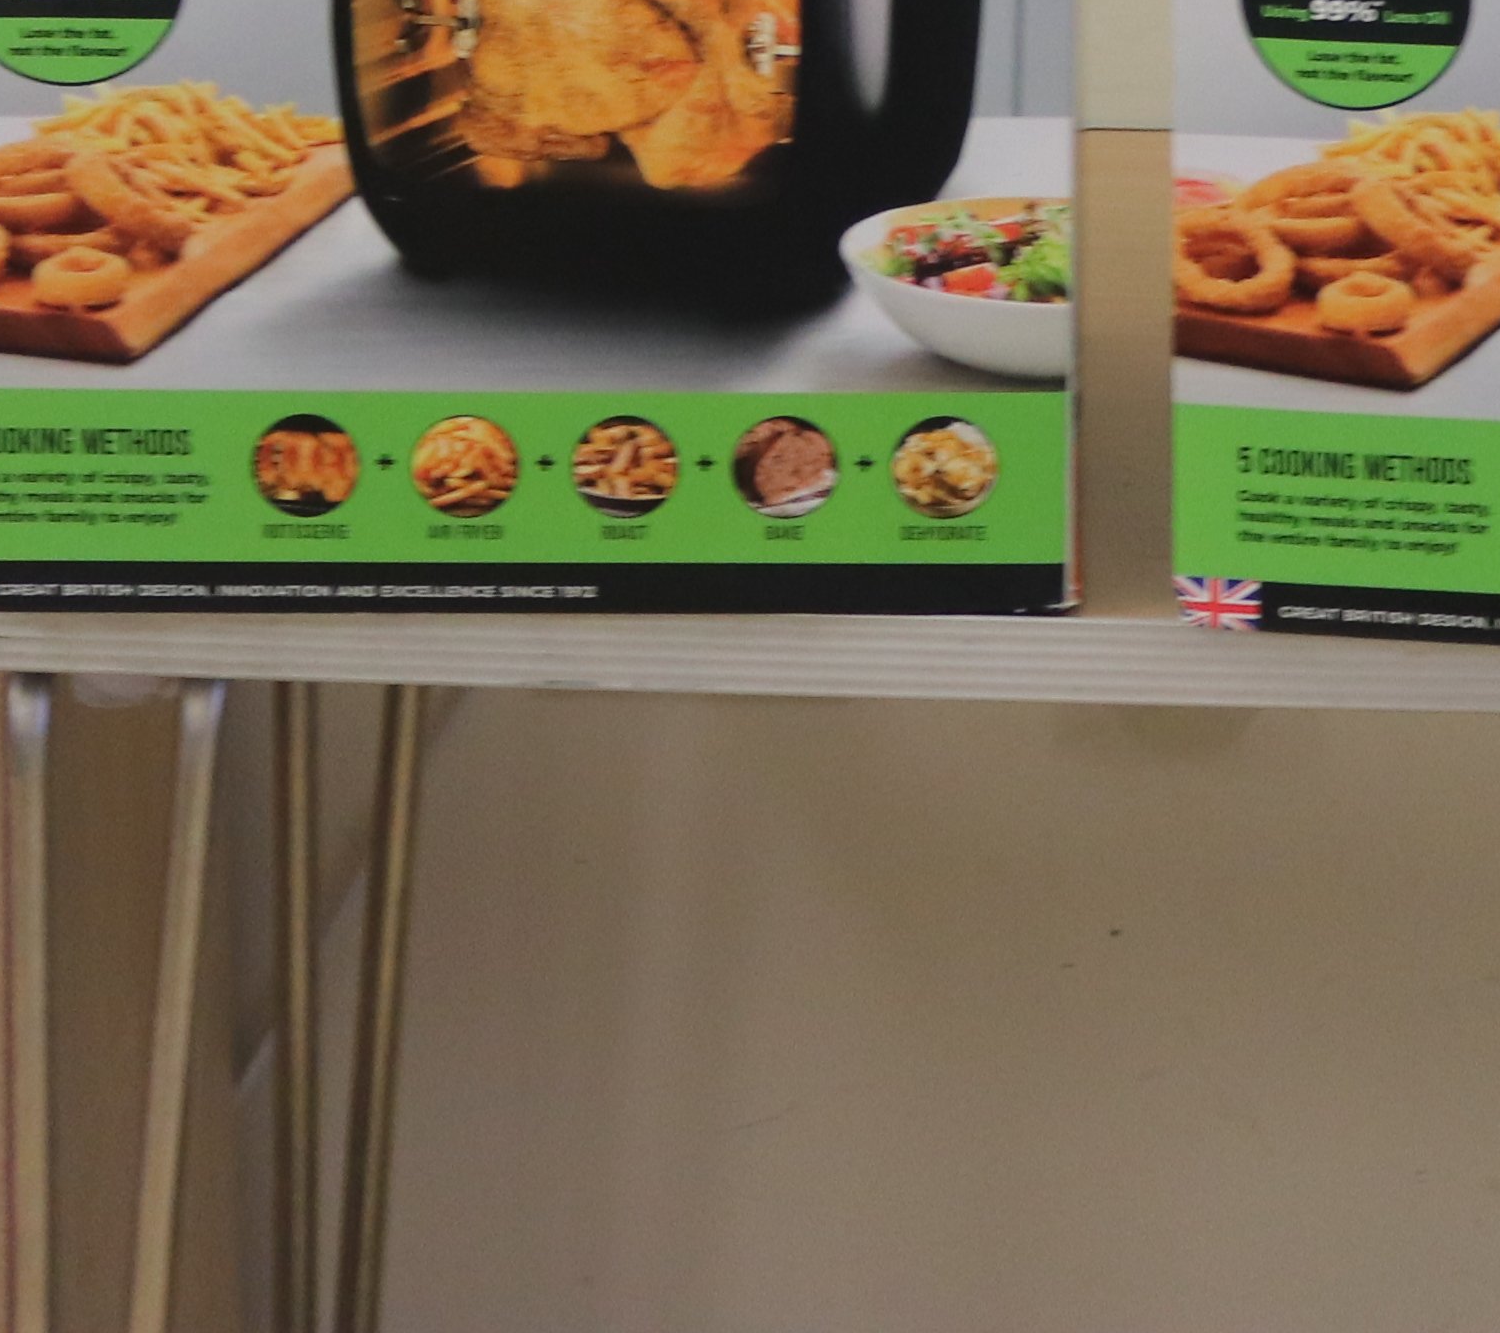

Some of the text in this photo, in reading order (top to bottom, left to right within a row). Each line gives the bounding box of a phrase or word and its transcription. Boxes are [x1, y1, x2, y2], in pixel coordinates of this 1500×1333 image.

[81, 428, 192, 455] METHODS
[1238, 447, 1472, 484] 5 COOKING METHODS
